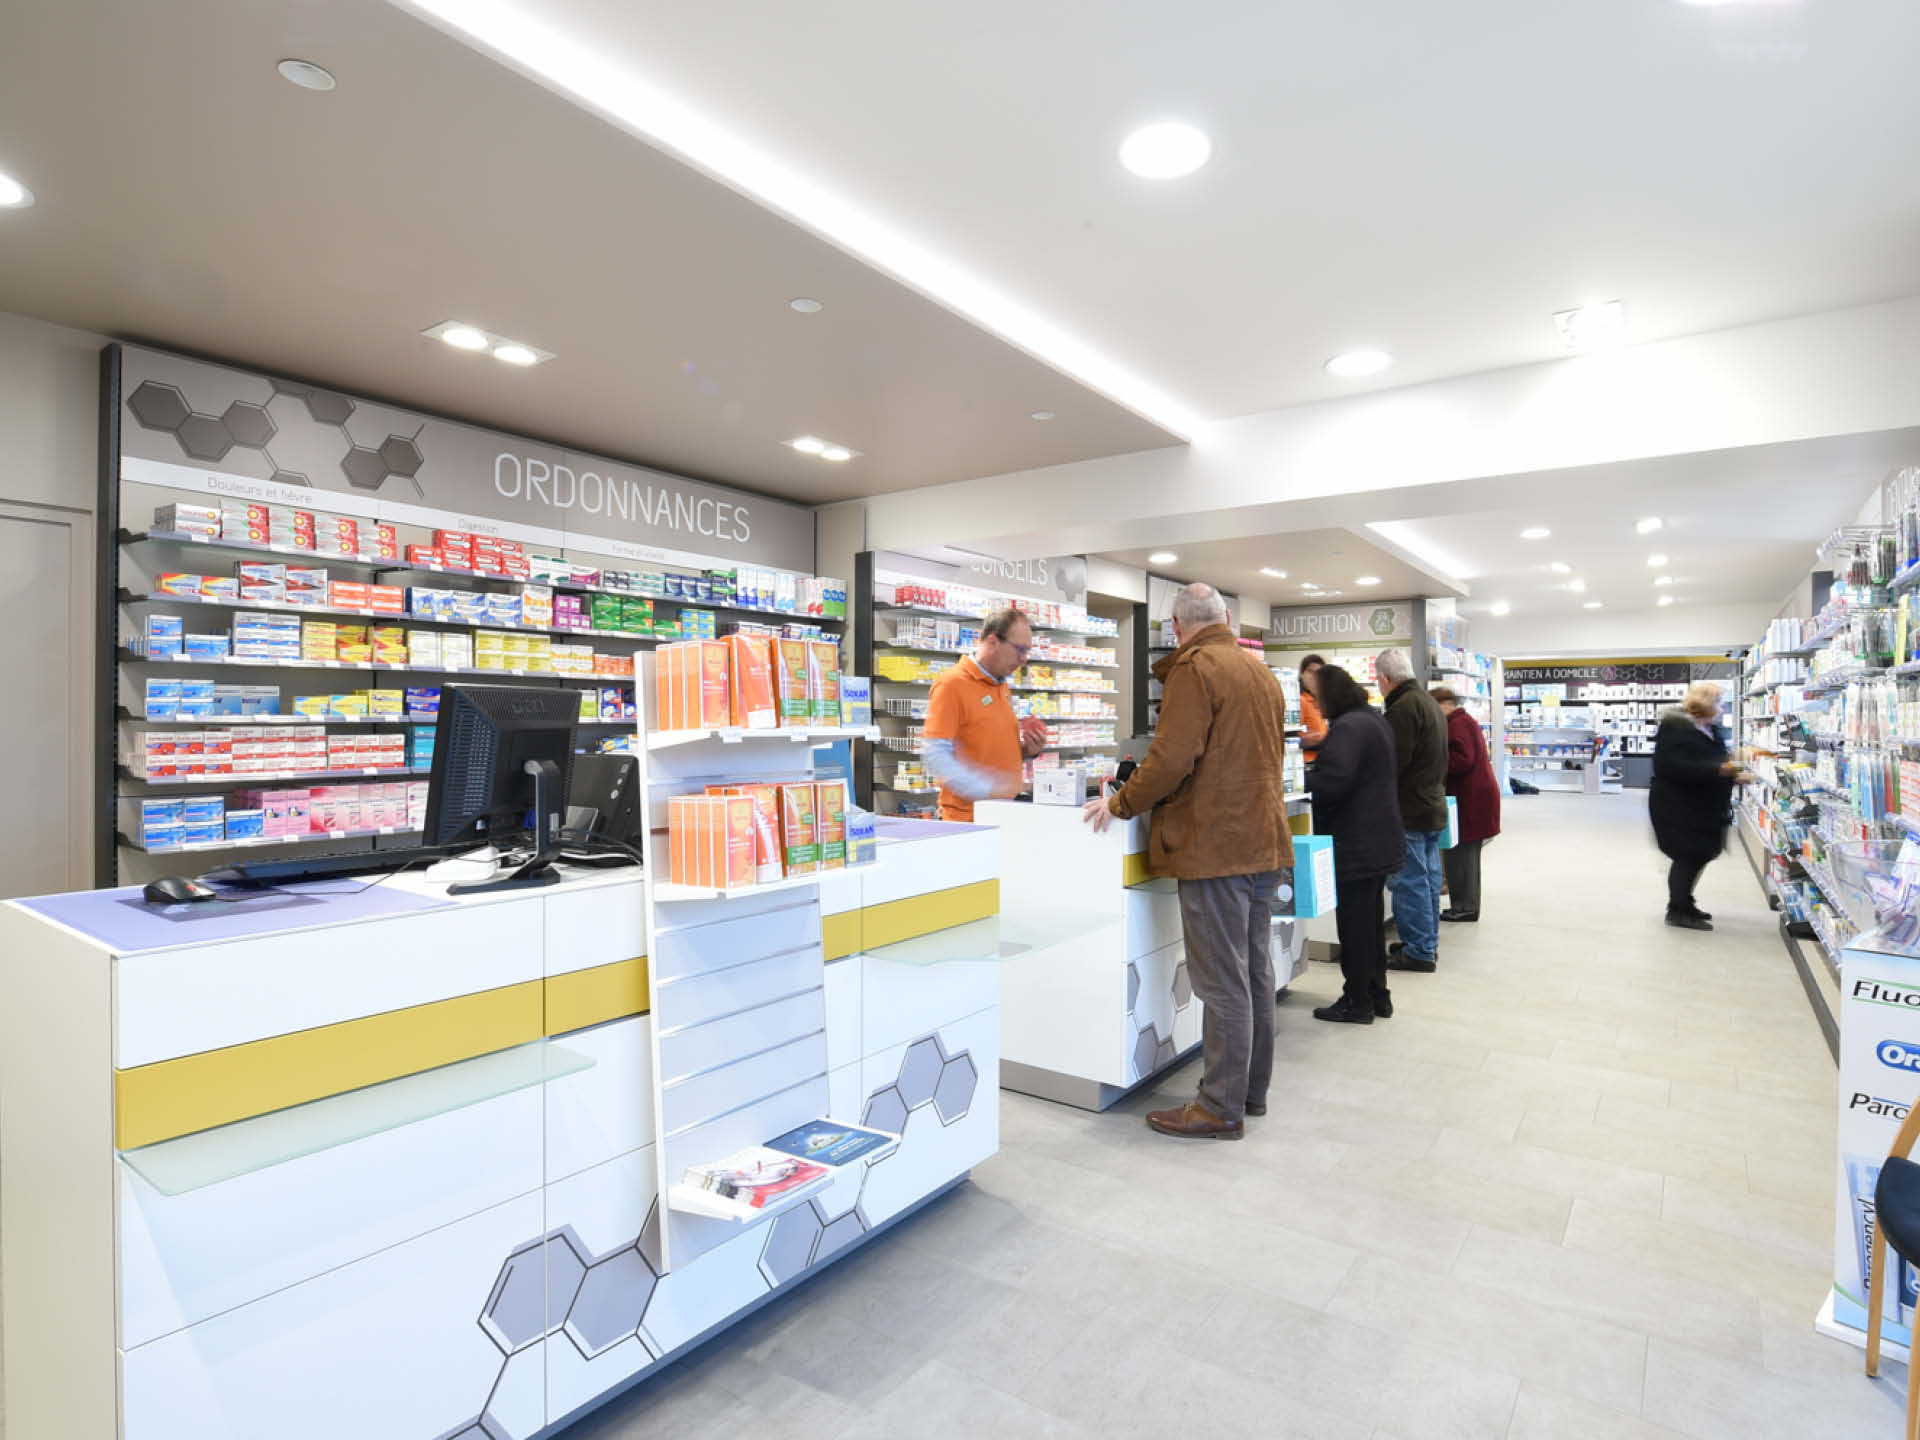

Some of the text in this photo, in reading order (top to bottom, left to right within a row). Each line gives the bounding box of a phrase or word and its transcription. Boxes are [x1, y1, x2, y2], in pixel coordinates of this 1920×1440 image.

[207, 476, 262, 496] Douleurs
[494, 452, 751, 543] ORDONNANCES
[1273, 613, 1361, 636] NUTRITION
[1553, 667, 1599, 680] DOMICILE
